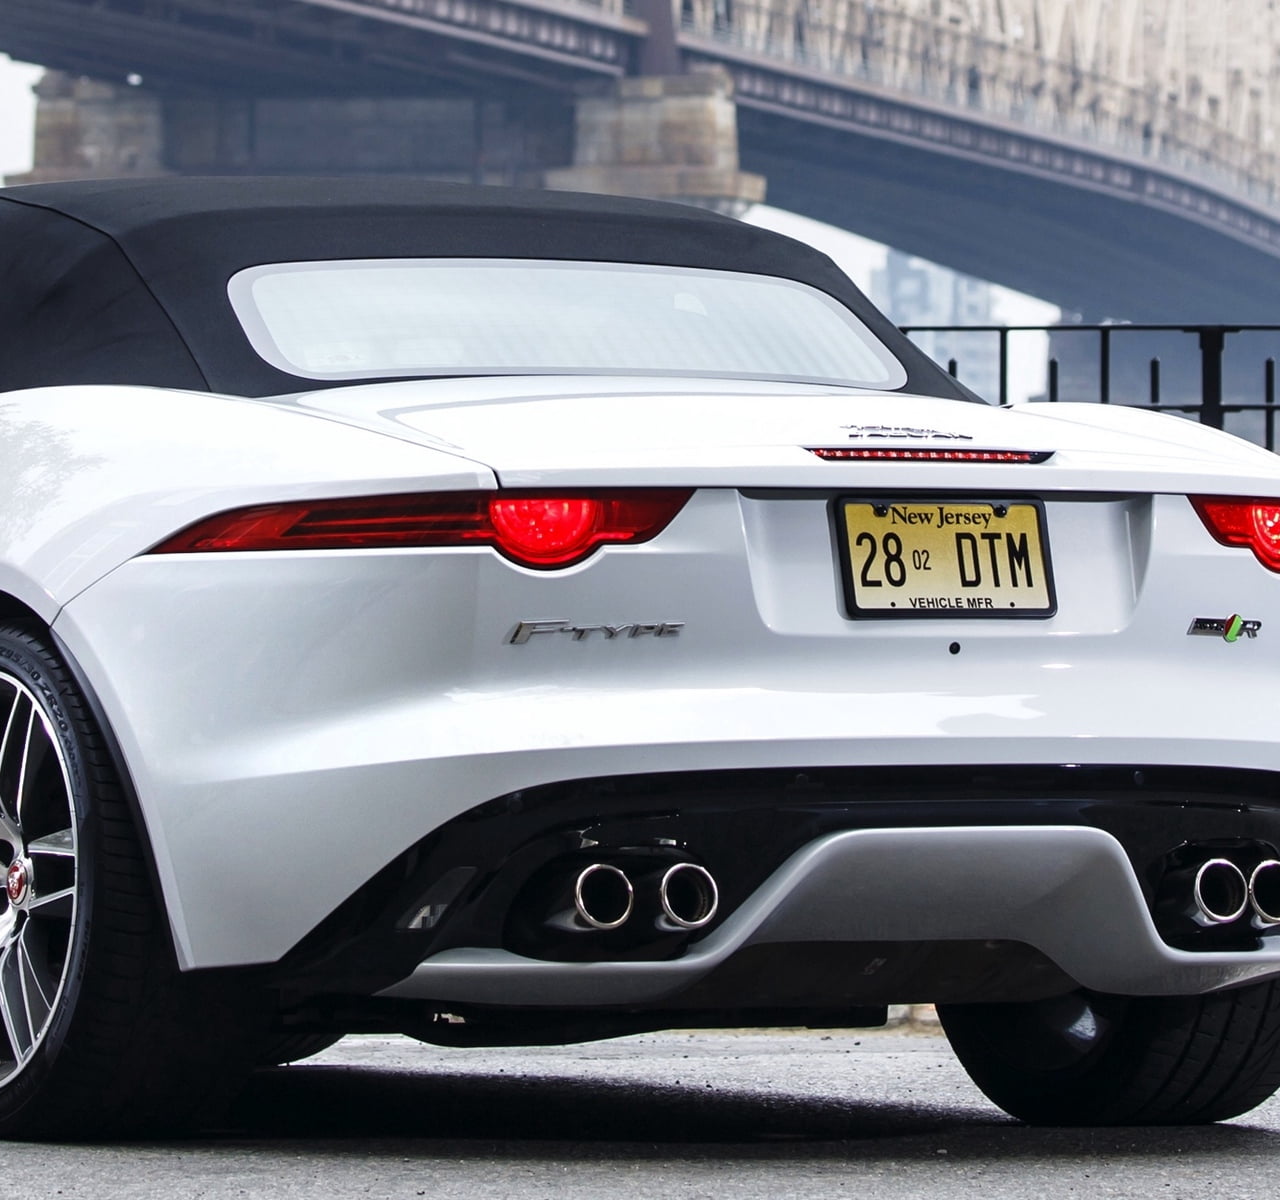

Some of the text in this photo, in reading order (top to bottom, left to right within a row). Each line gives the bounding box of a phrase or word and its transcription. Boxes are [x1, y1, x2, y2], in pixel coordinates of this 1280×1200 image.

[891, 506, 992, 529] New Jersey
[855, 532, 1034, 588] 28 02 DTM
[909, 597, 994, 609] VEHICLE MFR
